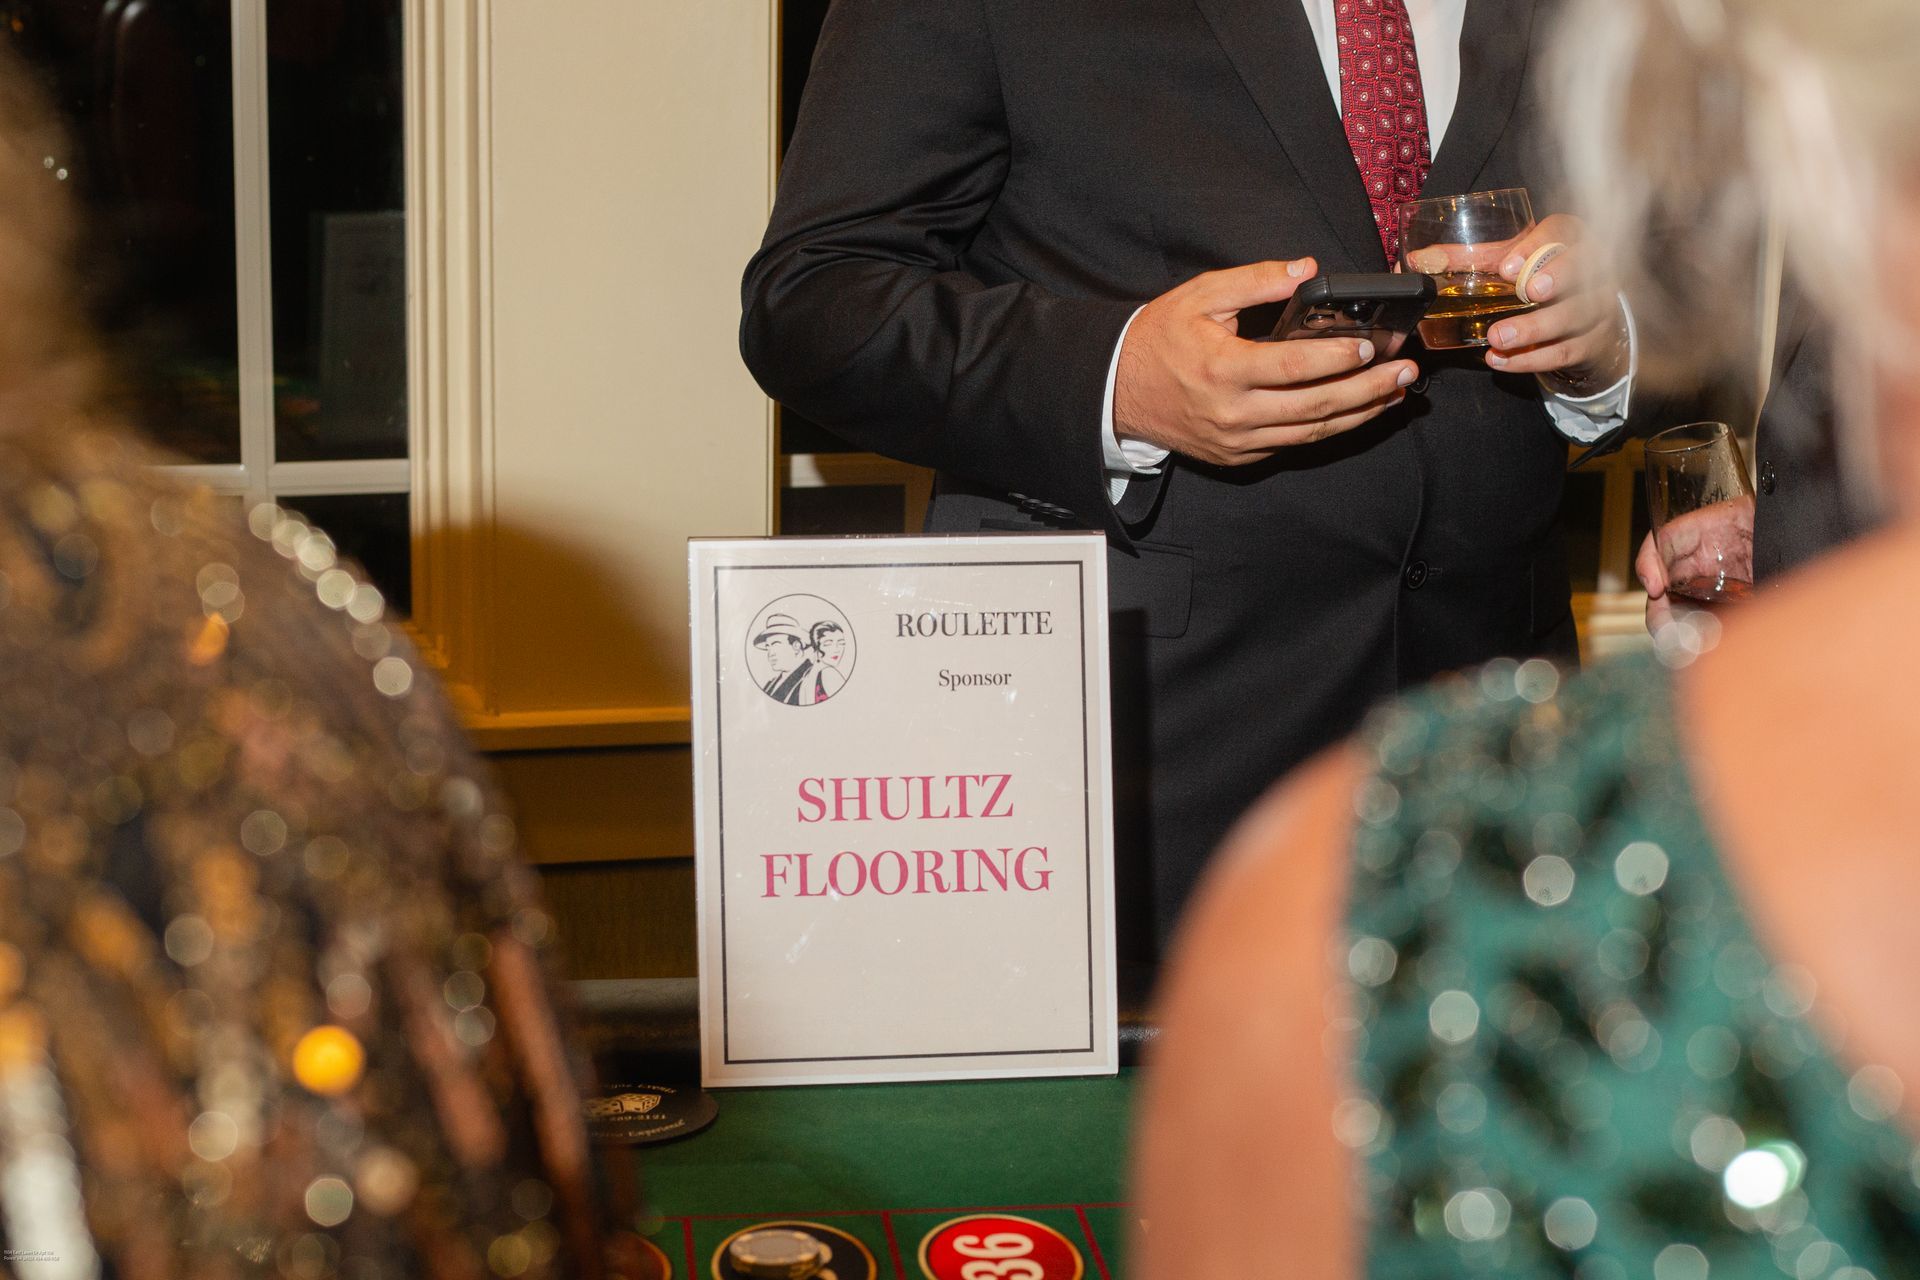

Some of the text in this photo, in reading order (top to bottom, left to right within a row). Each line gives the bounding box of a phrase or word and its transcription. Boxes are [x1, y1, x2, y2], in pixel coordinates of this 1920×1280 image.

[896, 611, 1053, 637] ROULETTE
[939, 669, 1012, 691] Sponsor
[797, 773, 1013, 822] SHULTZ
[760, 846, 1054, 898] FLOORING
[953, 1232, 1044, 1280] 36
